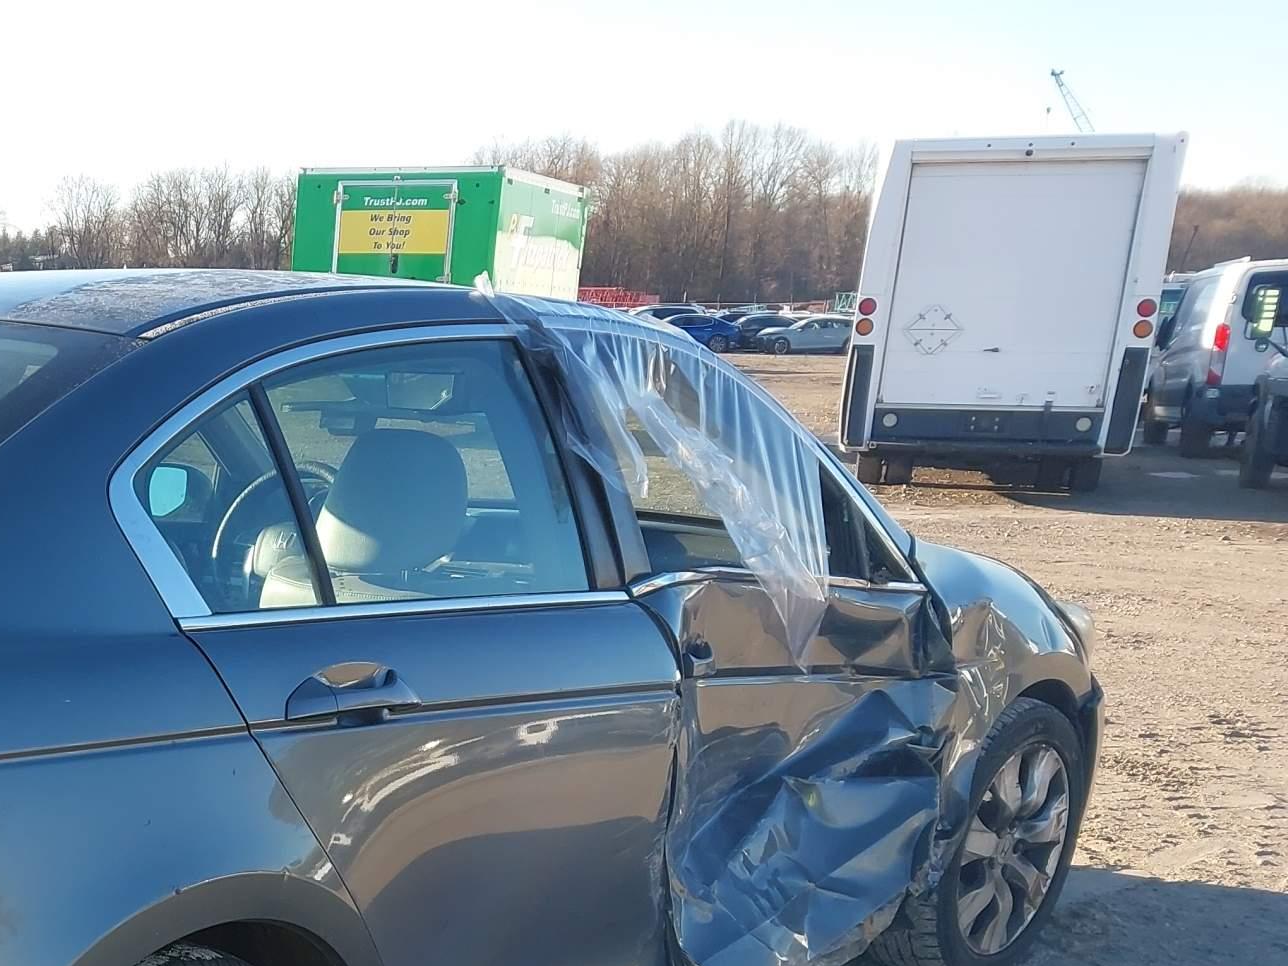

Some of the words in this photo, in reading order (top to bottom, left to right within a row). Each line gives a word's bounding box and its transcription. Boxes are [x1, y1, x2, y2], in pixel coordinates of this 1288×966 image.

[370, 213, 384, 222] We
[387, 213, 412, 224] Bring
[369, 227, 386, 236] Our
[388, 227, 410, 238] Shop
[373, 241, 383, 249] To
[386, 241, 406, 249] You!
